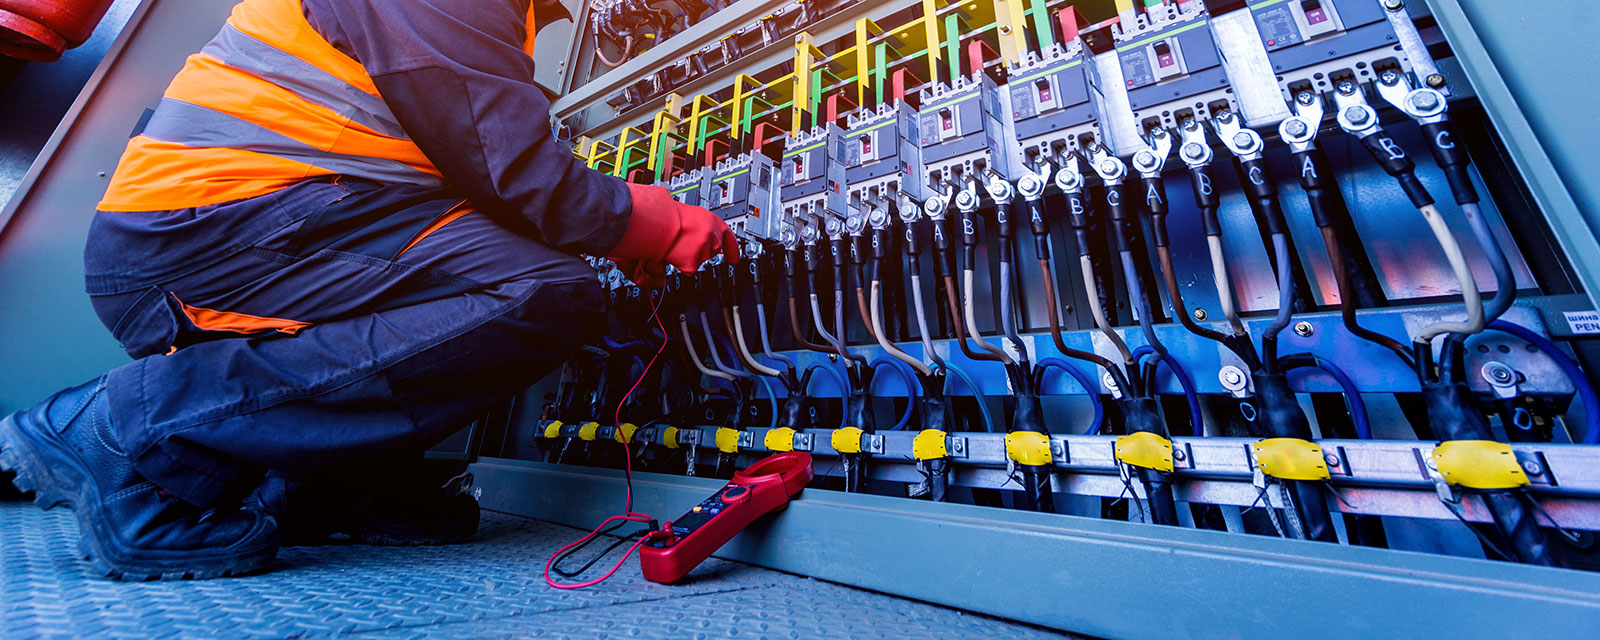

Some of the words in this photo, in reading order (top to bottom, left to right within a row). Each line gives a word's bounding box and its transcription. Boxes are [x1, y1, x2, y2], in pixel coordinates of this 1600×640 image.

[1378, 137, 1406, 160] B
[1435, 130, 1455, 150] C
[1302, 155, 1317, 179] A
[1248, 166, 1264, 186] C
[1199, 173, 1213, 197] B
[1107, 190, 1120, 207] C
[1146, 183, 1163, 206] A
[1031, 206, 1042, 224] A
[1070, 198, 1085, 216] B
[998, 211, 1007, 224] C
[934, 224, 944, 242] A
[963, 218, 975, 236] B
[872, 234, 879, 249] B
[905, 231, 912, 242] C
[804, 251, 811, 263] B
[831, 245, 838, 256] C
[850, 244, 857, 258] A
[784, 254, 790, 268] A
[1568, 314, 1599, 322] шина
[1575, 323, 1600, 332] PEN
